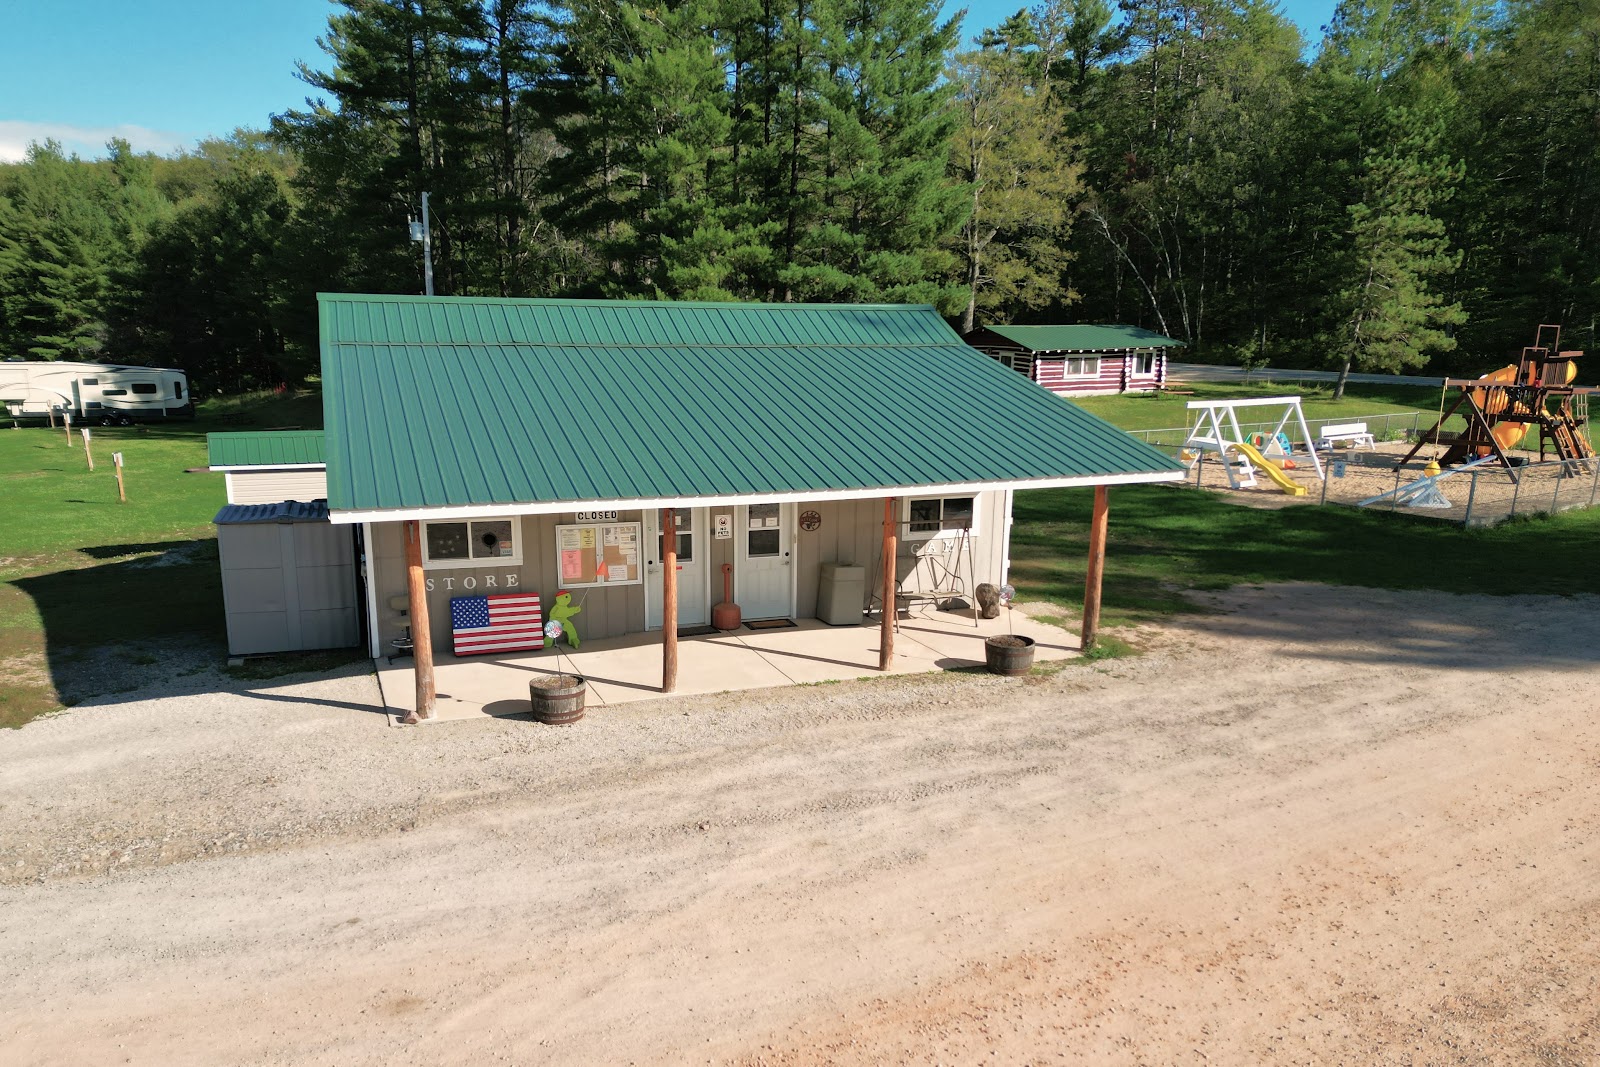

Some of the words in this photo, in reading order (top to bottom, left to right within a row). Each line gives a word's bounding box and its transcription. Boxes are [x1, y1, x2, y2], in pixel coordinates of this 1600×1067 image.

[578, 511, 616, 520] CLOSED
[910, 540, 969, 554] GAME
[426, 574, 519, 591] STORE
